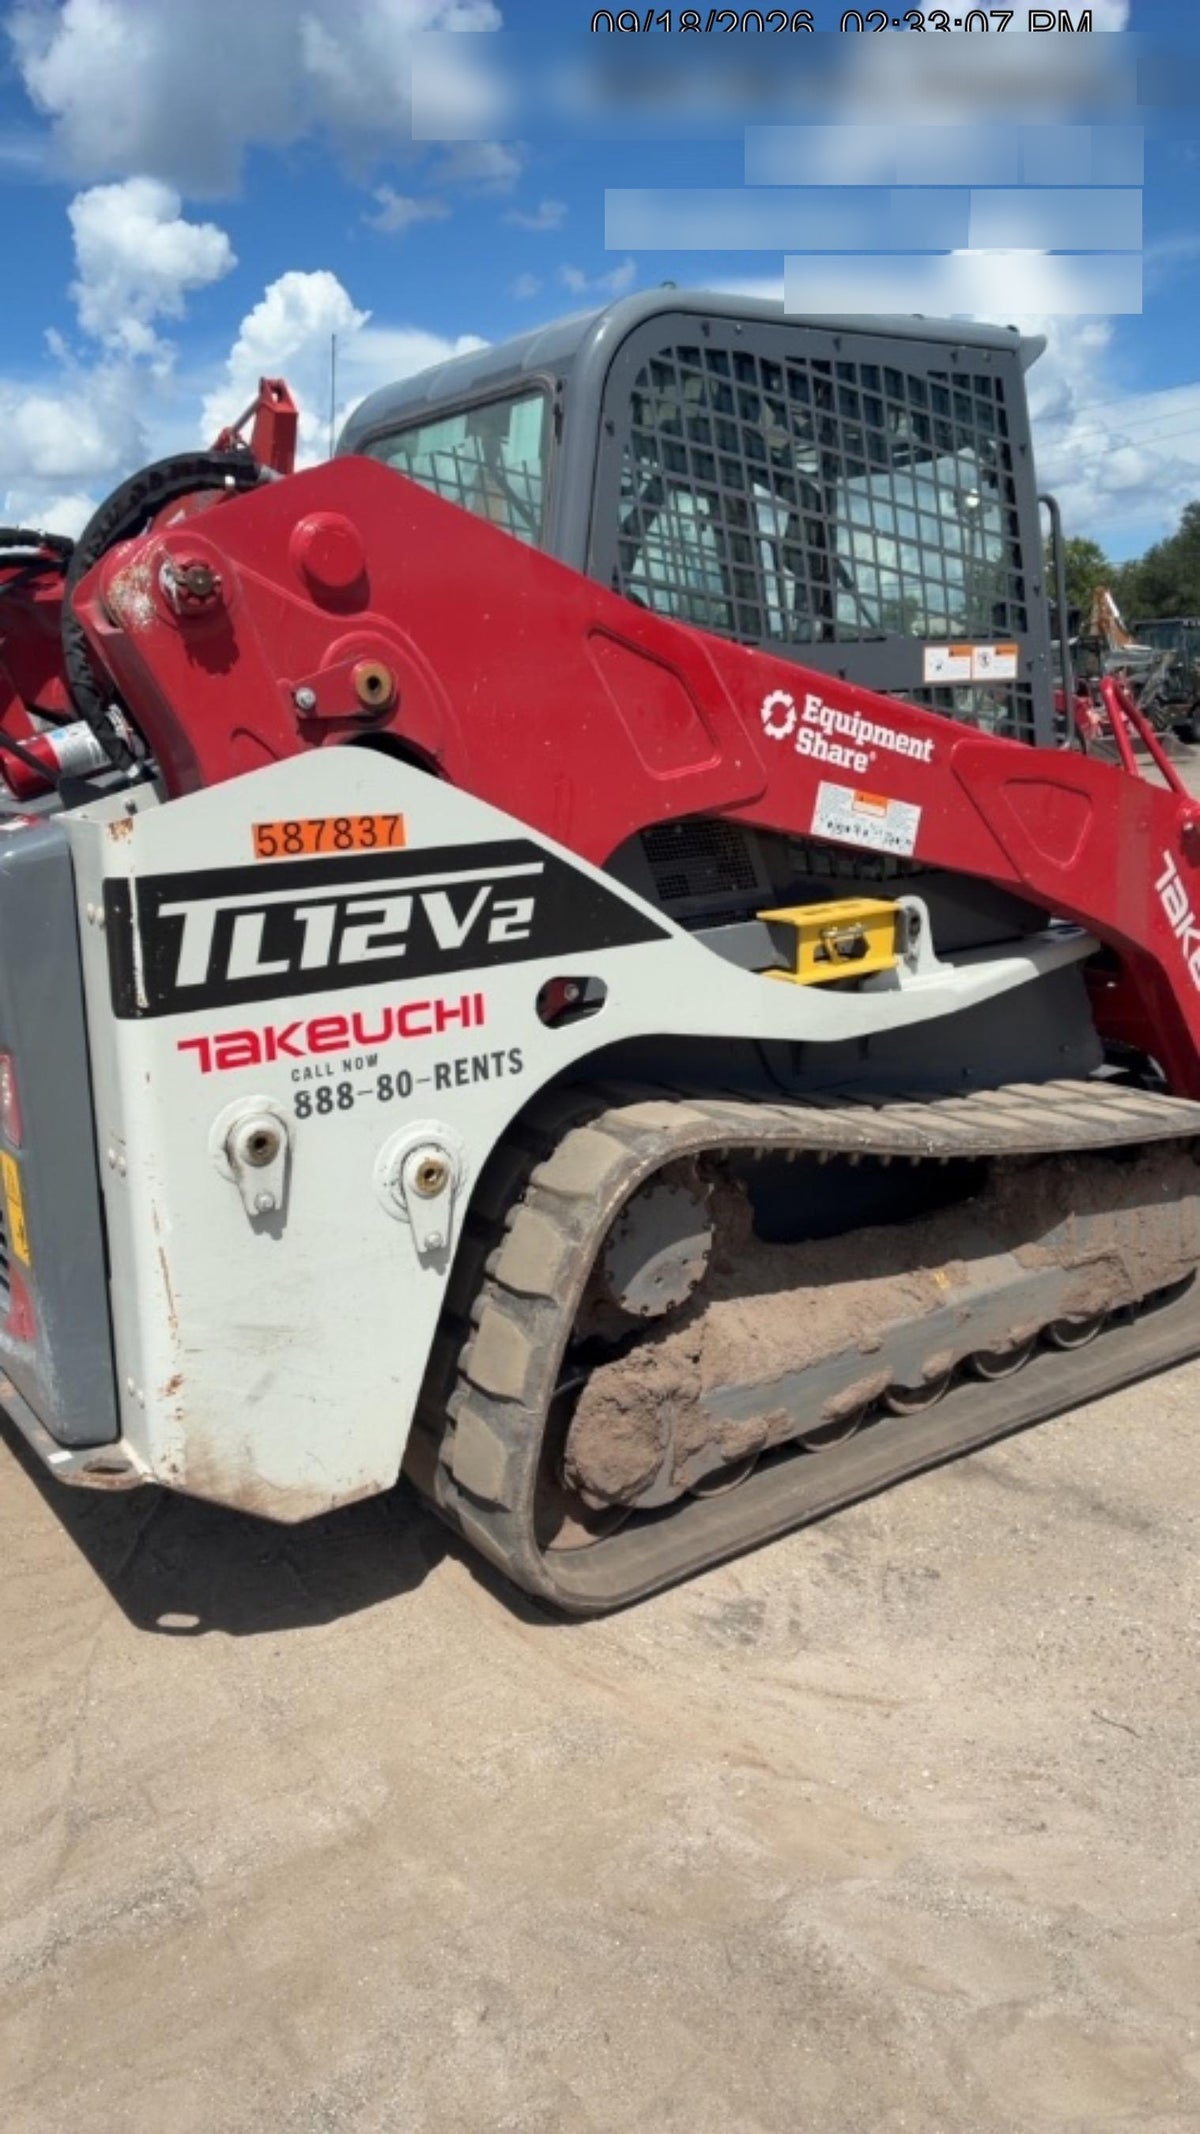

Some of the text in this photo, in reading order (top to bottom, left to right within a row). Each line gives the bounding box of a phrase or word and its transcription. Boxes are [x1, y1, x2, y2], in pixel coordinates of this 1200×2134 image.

[801, 693, 936, 763] Equipment
[256, 814, 402, 858] 587837
[157, 862, 544, 988] TL12V2
[177, 993, 485, 1074] TAKEUCHI
[291, 1053, 379, 1082] CALL NOW
[293, 1048, 524, 1120] 888-80-RENTS
